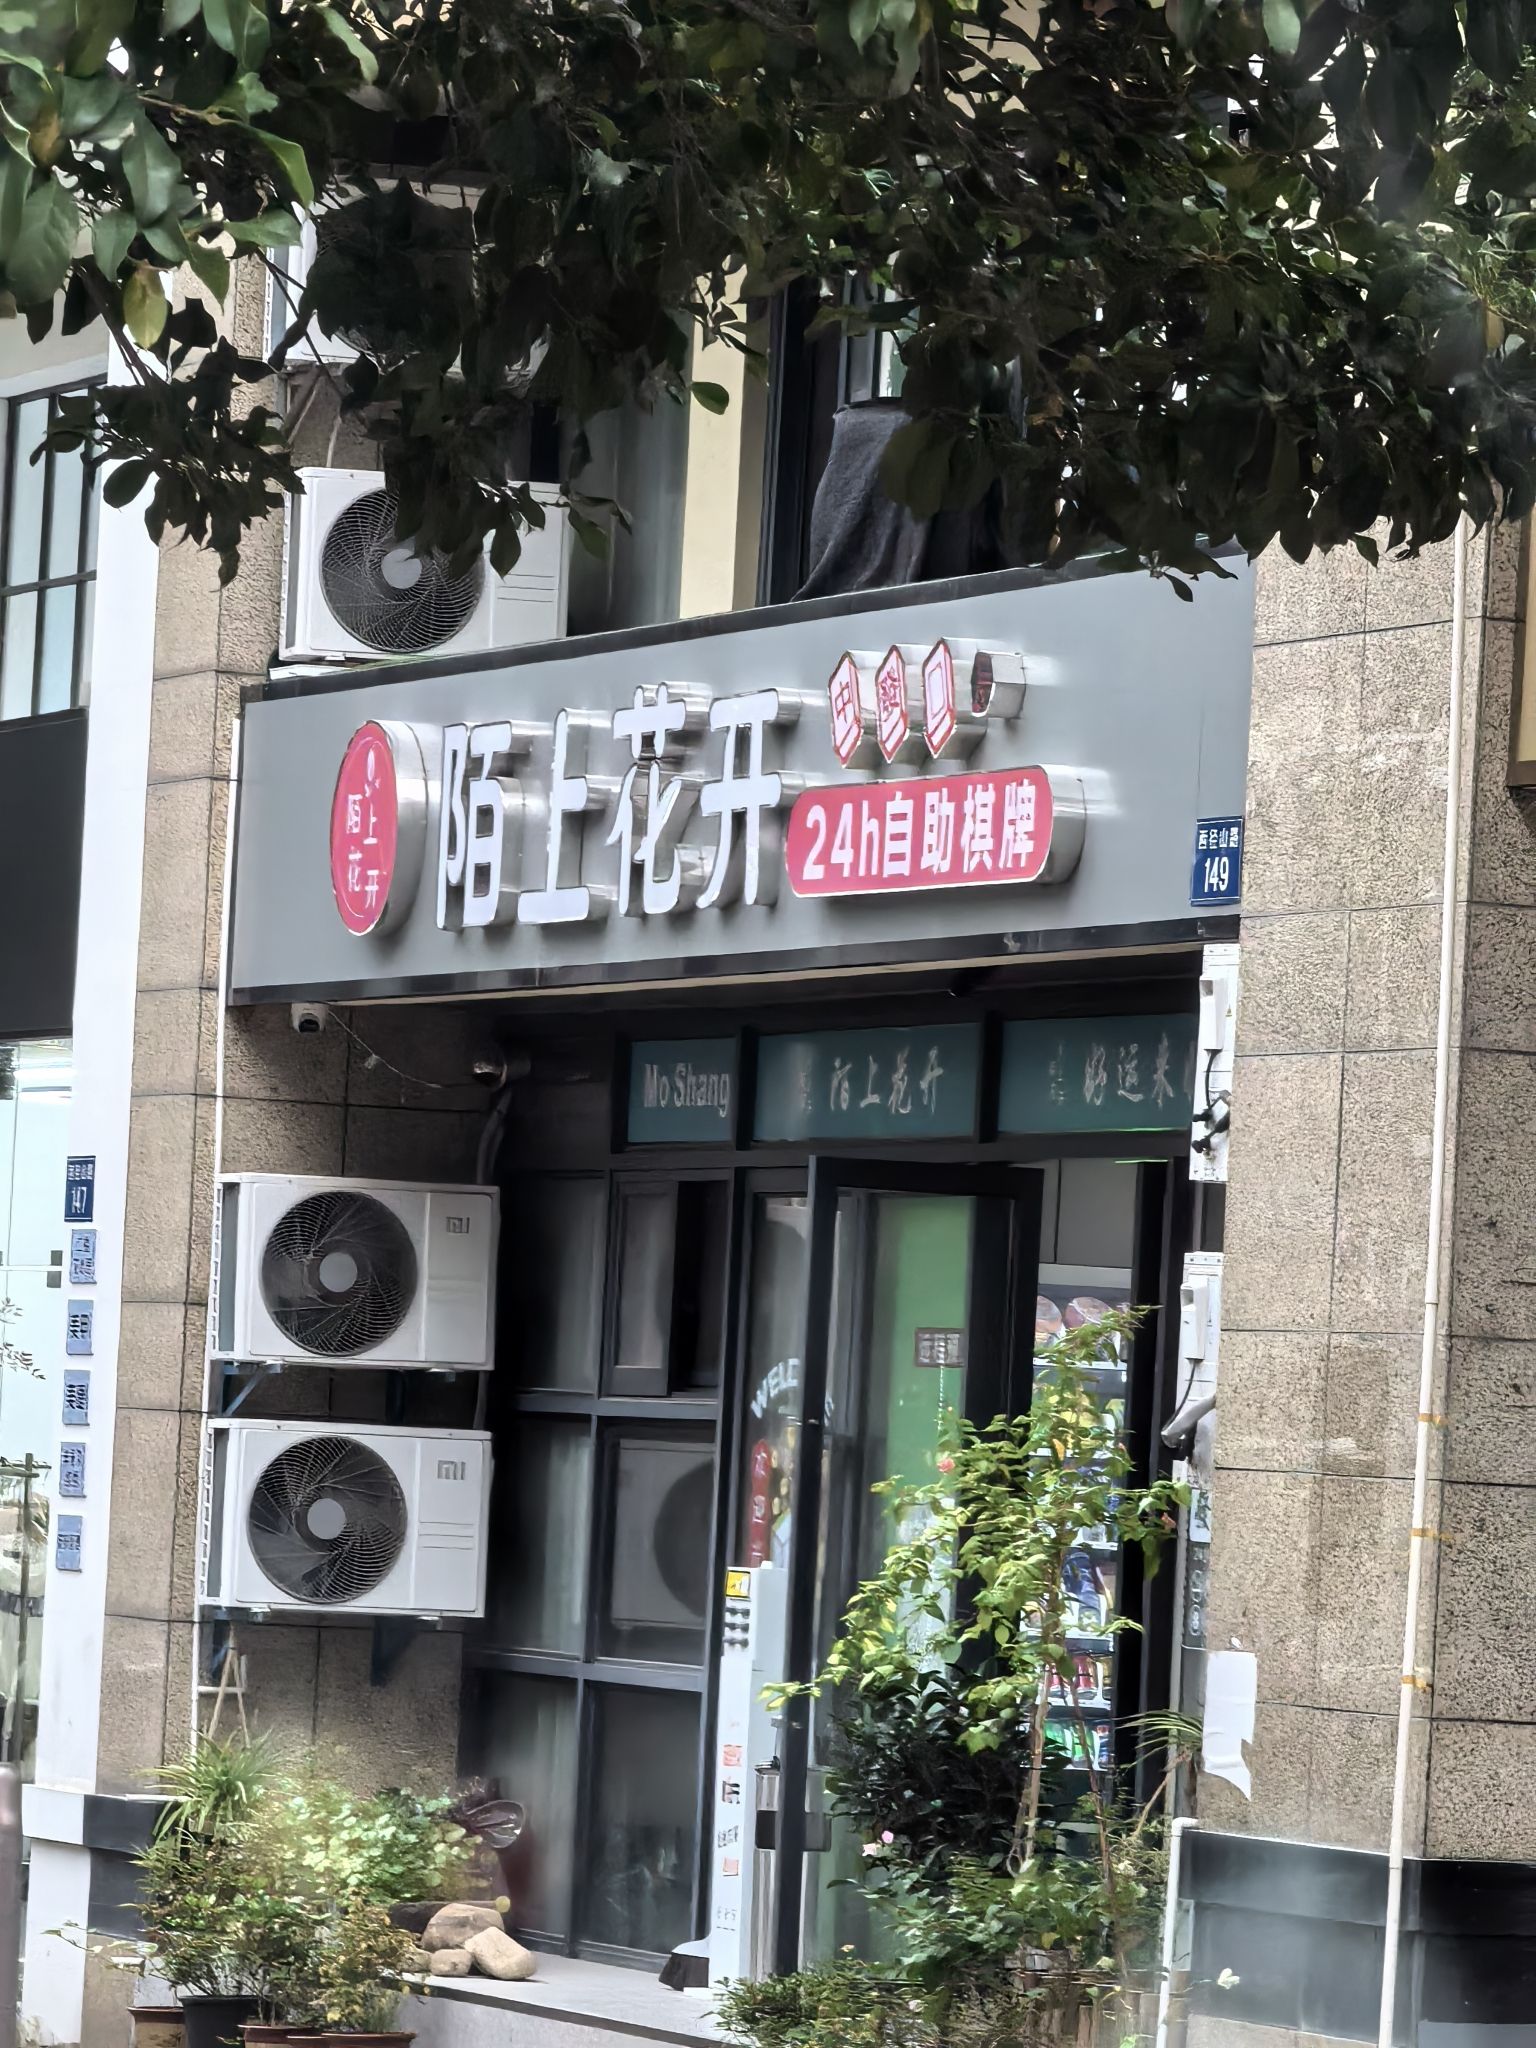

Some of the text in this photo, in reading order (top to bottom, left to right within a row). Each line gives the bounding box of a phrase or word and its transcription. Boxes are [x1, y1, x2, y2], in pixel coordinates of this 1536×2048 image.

[437, 682, 780, 929] 陌上花开
[801, 778, 1038, 880] 24h自助棋牌
[1204, 856, 1230, 893] 149
[674, 1062, 730, 1118] Shang
